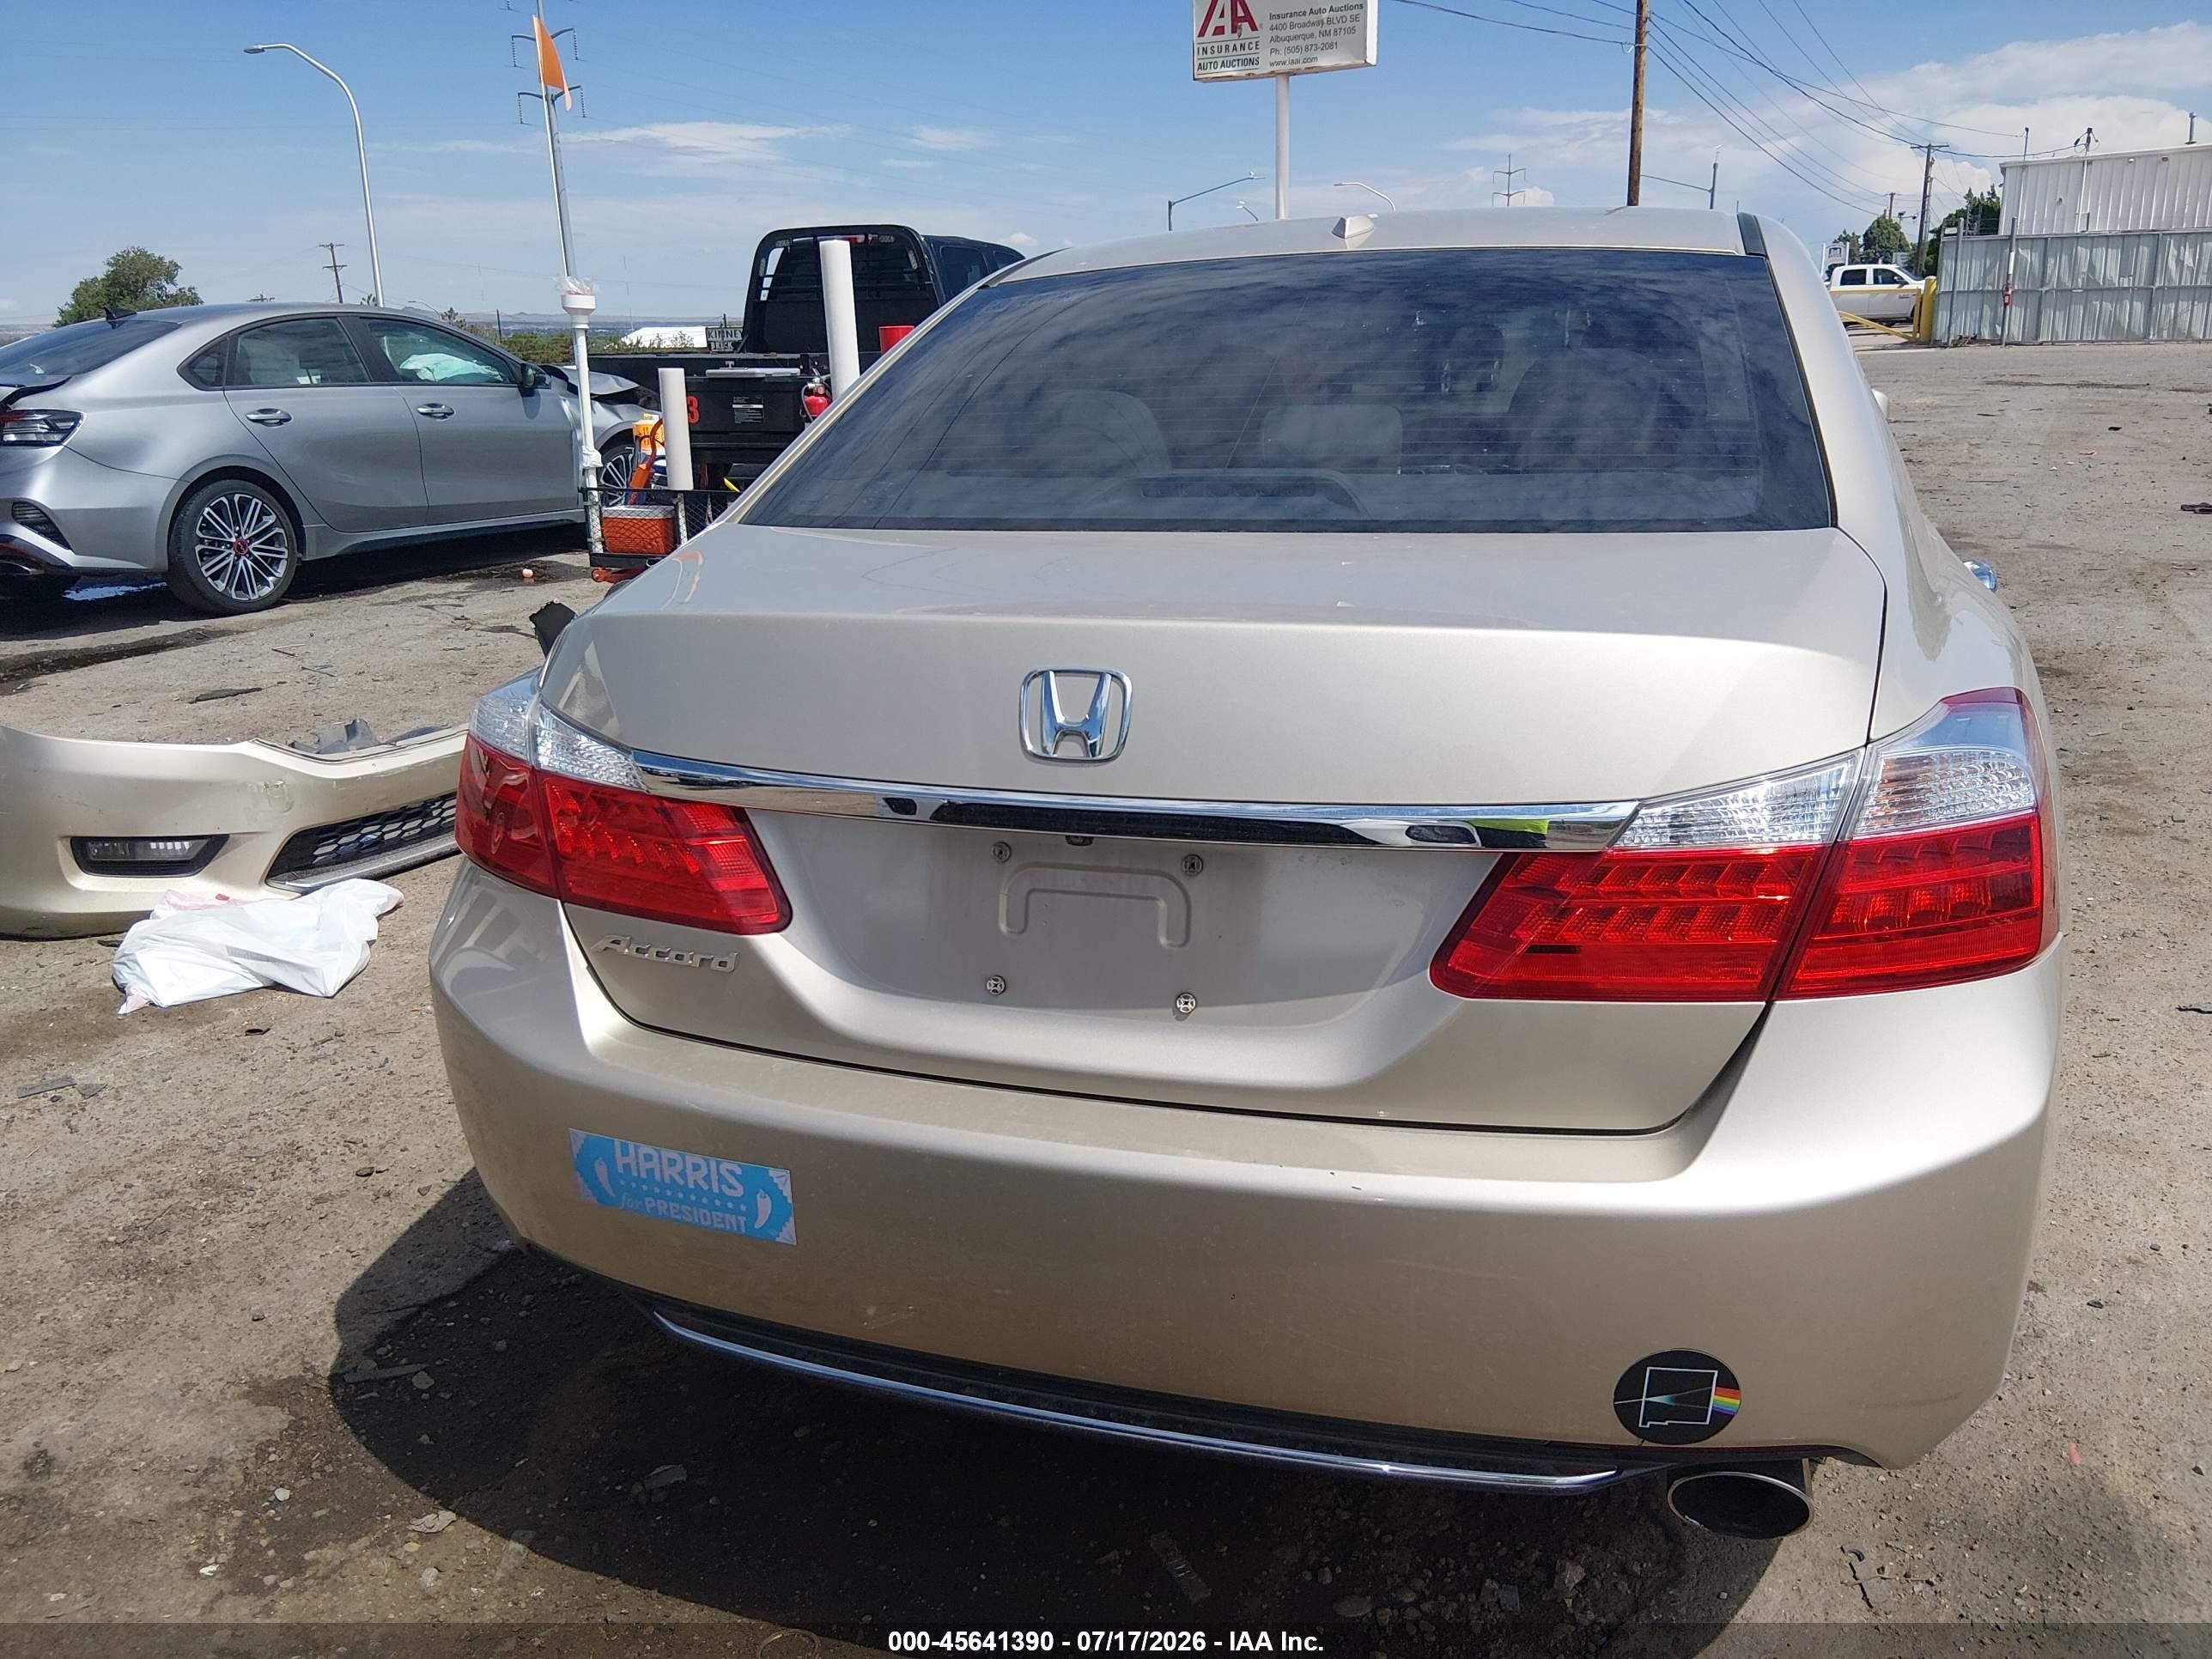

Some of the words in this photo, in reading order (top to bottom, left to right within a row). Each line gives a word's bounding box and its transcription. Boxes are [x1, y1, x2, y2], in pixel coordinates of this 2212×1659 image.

[1269, 10, 1307, 21] Insurance
[1309, 7, 1327, 16] Auto
[1328, 3, 1364, 13] Auctions
[1269, 22, 1288, 31] 4400
[1289, 18, 1325, 30] Broadway
[1326, 15, 1347, 26] BLVD
[1349, 13, 1361, 22] SE
[1269, 32, 1316, 43] Albuquerque,
[1318, 28, 1332, 38] NM
[1333, 26, 1357, 35] 87105
[1197, 40, 1260, 56] INSURANCE
[1270, 47, 1282, 56] Ph:
[1284, 46, 1303, 56] (505)
[1304, 41, 1338, 52] 873-2081
[1197, 60, 1218, 71] AUTO
[1220, 57, 1260, 70] AUCTIONS
[1269, 56, 1318, 67] www.iaai.com
[590, 933, 739, 973] Accord
[613, 1139, 743, 1198] HARRIS
[644, 1196, 747, 1234] PRESIDENT
